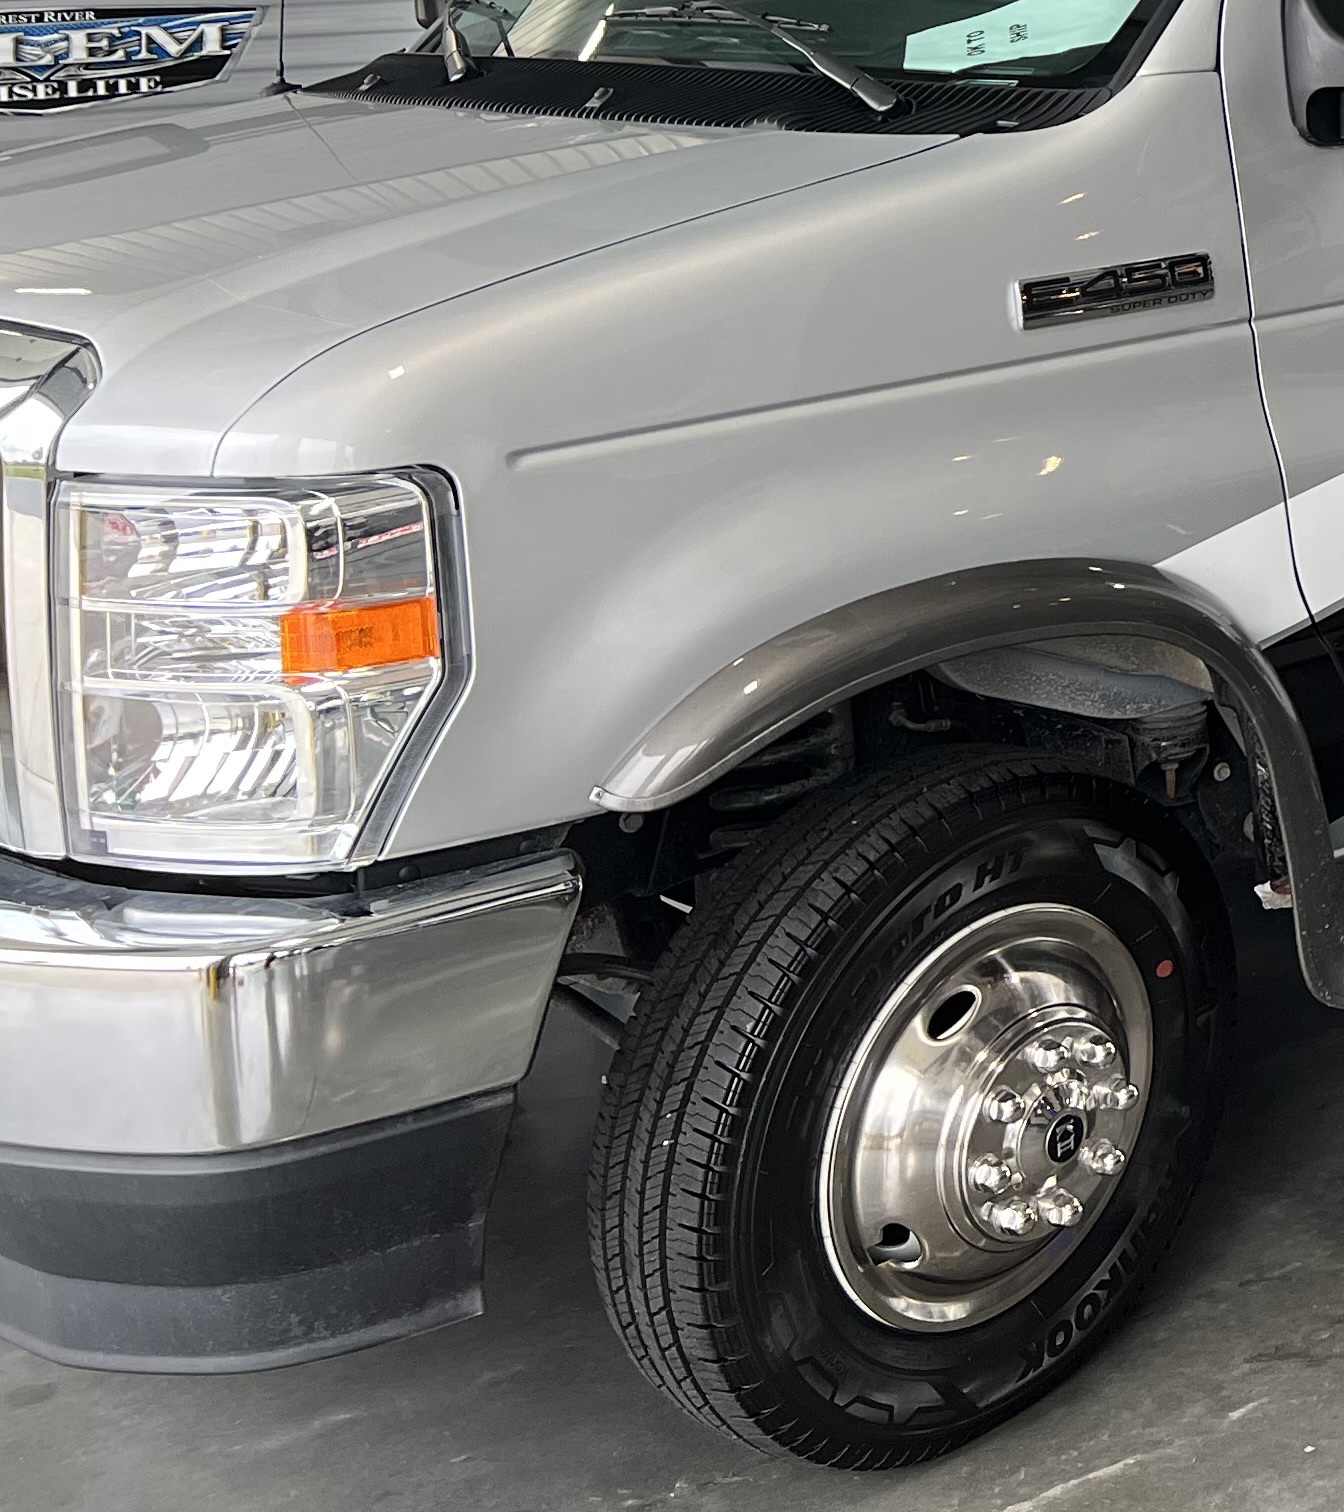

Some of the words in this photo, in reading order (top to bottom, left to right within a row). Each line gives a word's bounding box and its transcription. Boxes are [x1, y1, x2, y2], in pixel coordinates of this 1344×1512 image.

[43, 10, 96, 23] RIVER
[966, 30, 985, 44] TO
[966, 43, 985, 56] OK
[64, 74, 163, 97] LITE
[1110, 295, 1163, 314] SUPER
[1167, 289, 1210, 305] DUTY
